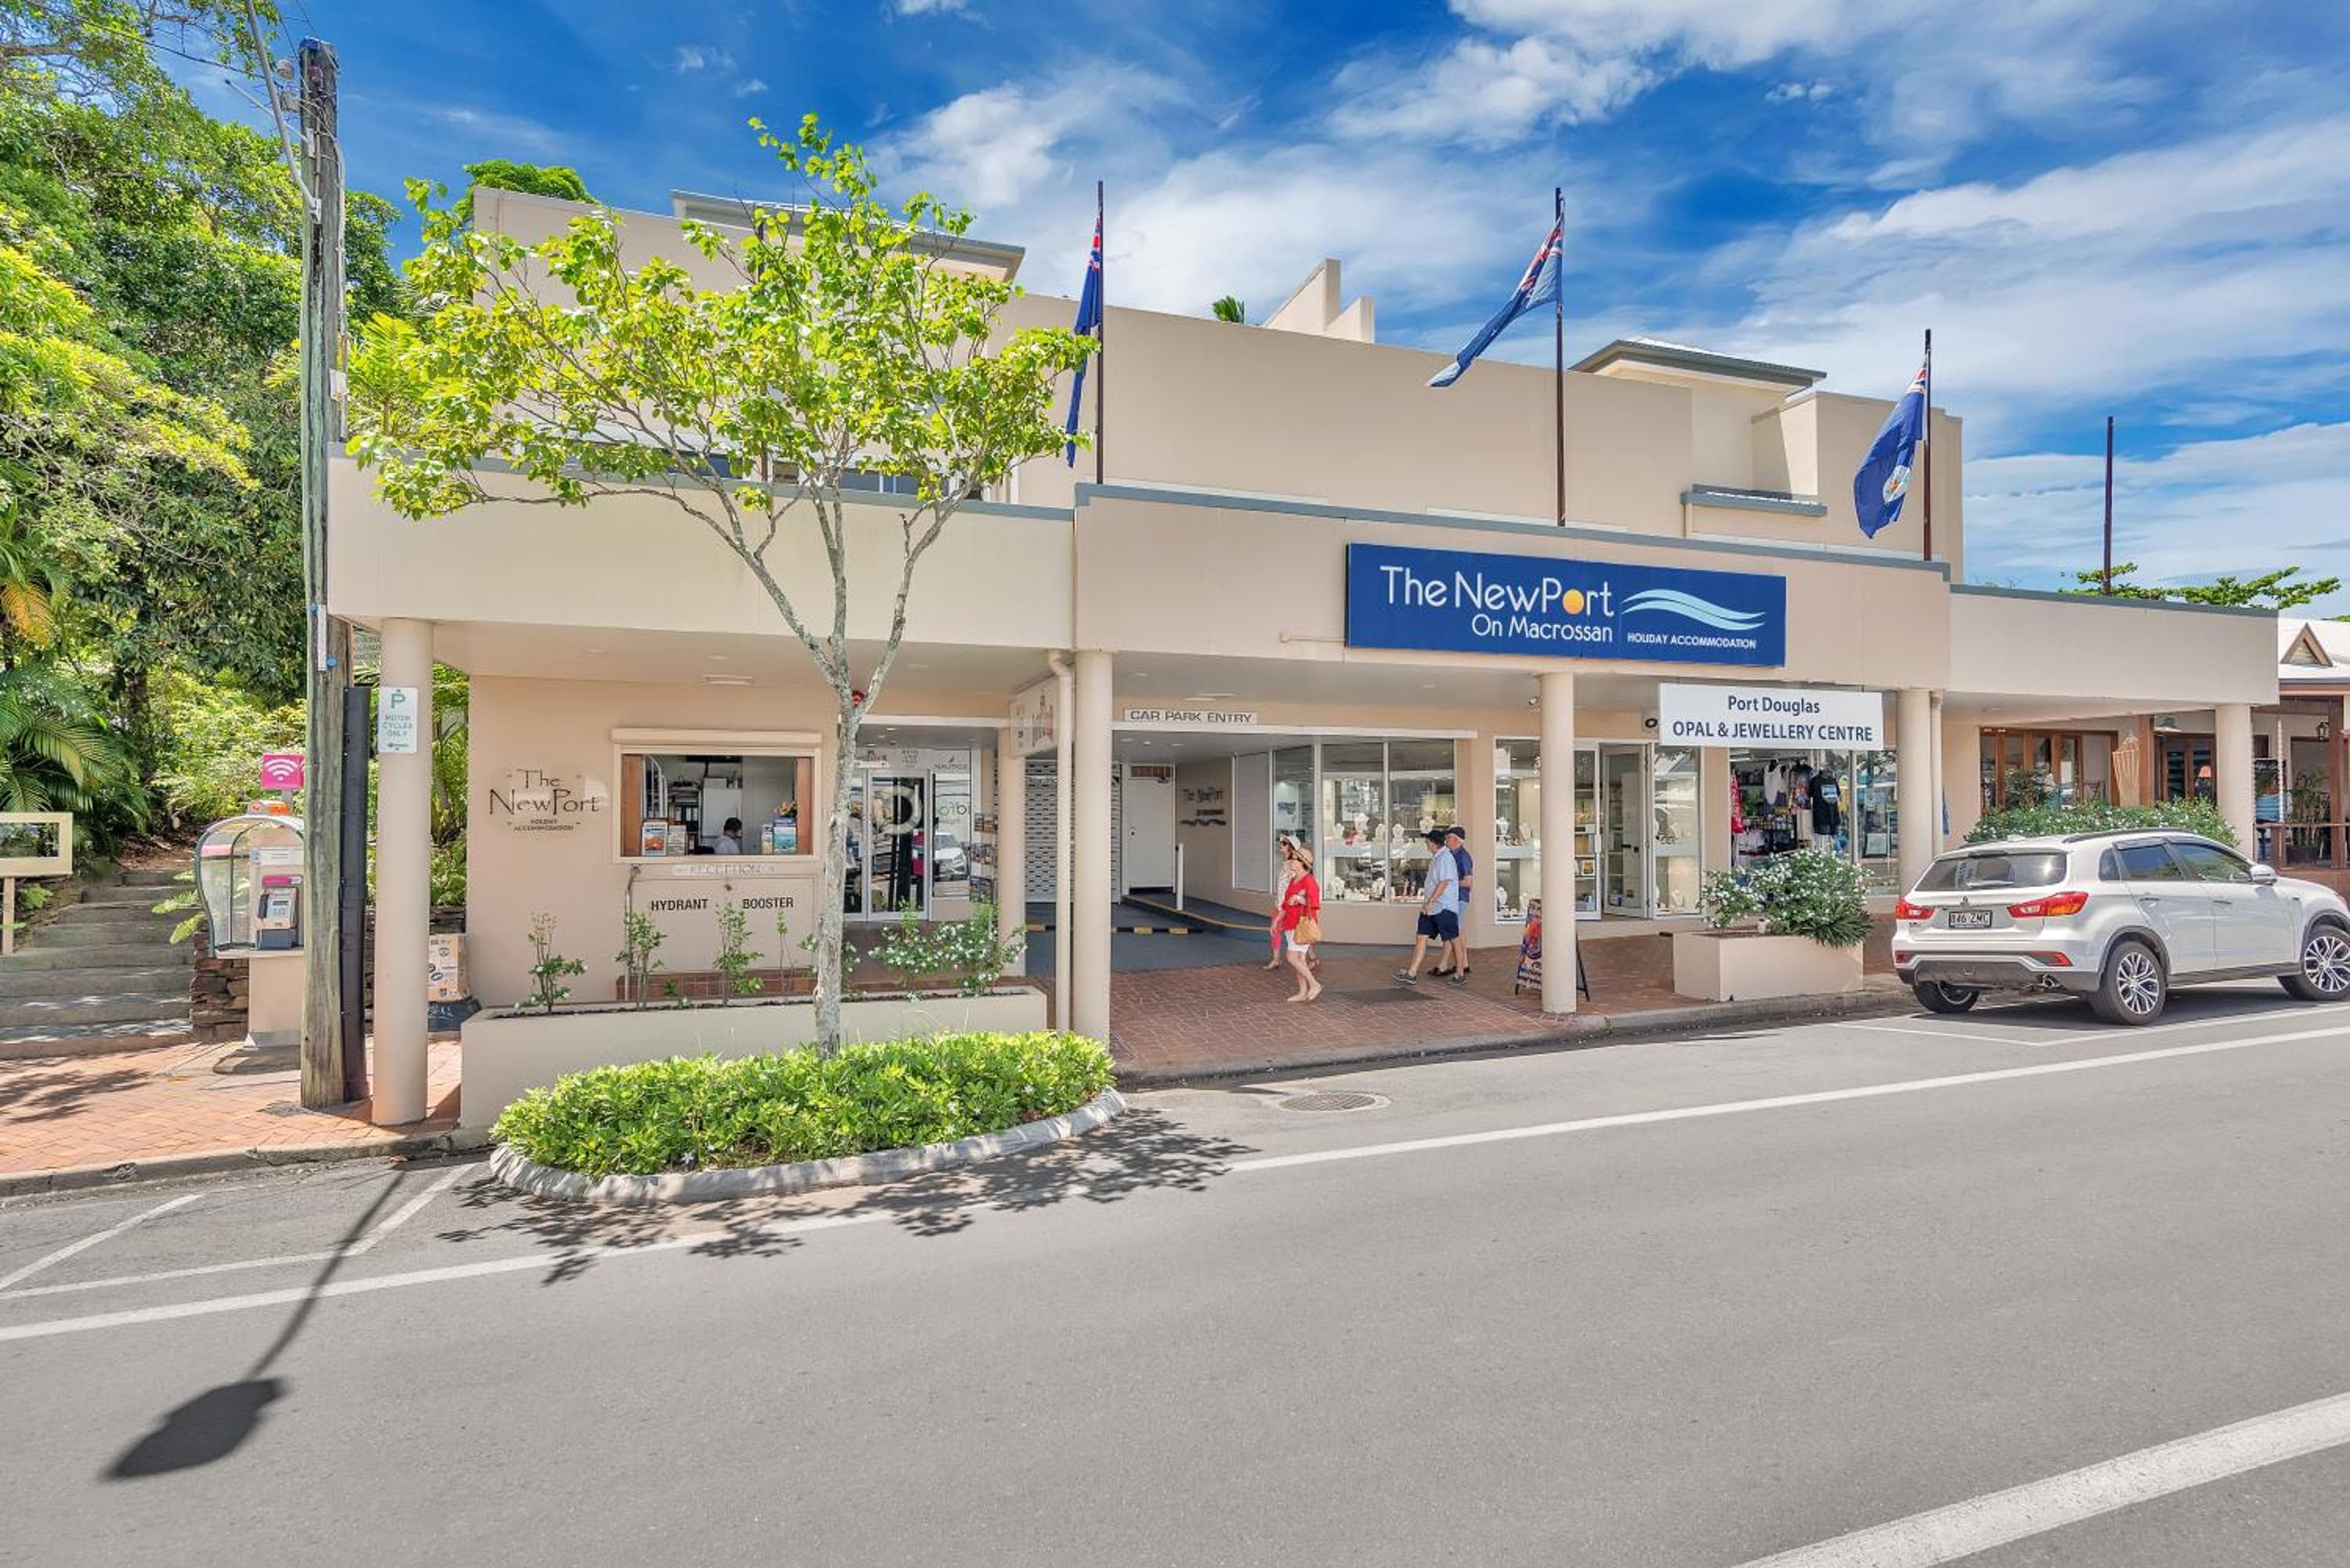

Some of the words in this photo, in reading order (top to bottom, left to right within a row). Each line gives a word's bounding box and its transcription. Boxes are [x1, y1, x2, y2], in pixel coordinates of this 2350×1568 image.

[1380, 565, 1447, 607] The
[1455, 570, 1614, 617] NewPort
[1472, 613, 1502, 638] On
[1509, 616, 1613, 643] Macrossan
[1627, 631, 1668, 645] HOLIDAY
[1670, 635, 1757, 649] ACCOMMODATION
[391, 693, 406, 709] P
[1728, 695, 1759, 712] Port
[1762, 696, 1820, 716] Douglas
[1130, 710, 1160, 721] CAR
[1165, 711, 1202, 721] PARK
[1207, 712, 1253, 723] ENTRY
[1672, 721, 1715, 737] OPAL
[1718, 722, 1729, 737] &
[1731, 722, 1814, 739] JEWELLERY
[1818, 724, 1873, 741] CENTRE
[516, 768, 561, 789] The
[651, 898, 709, 911] HYDRANT
[742, 898, 794, 909] BOOSTER
